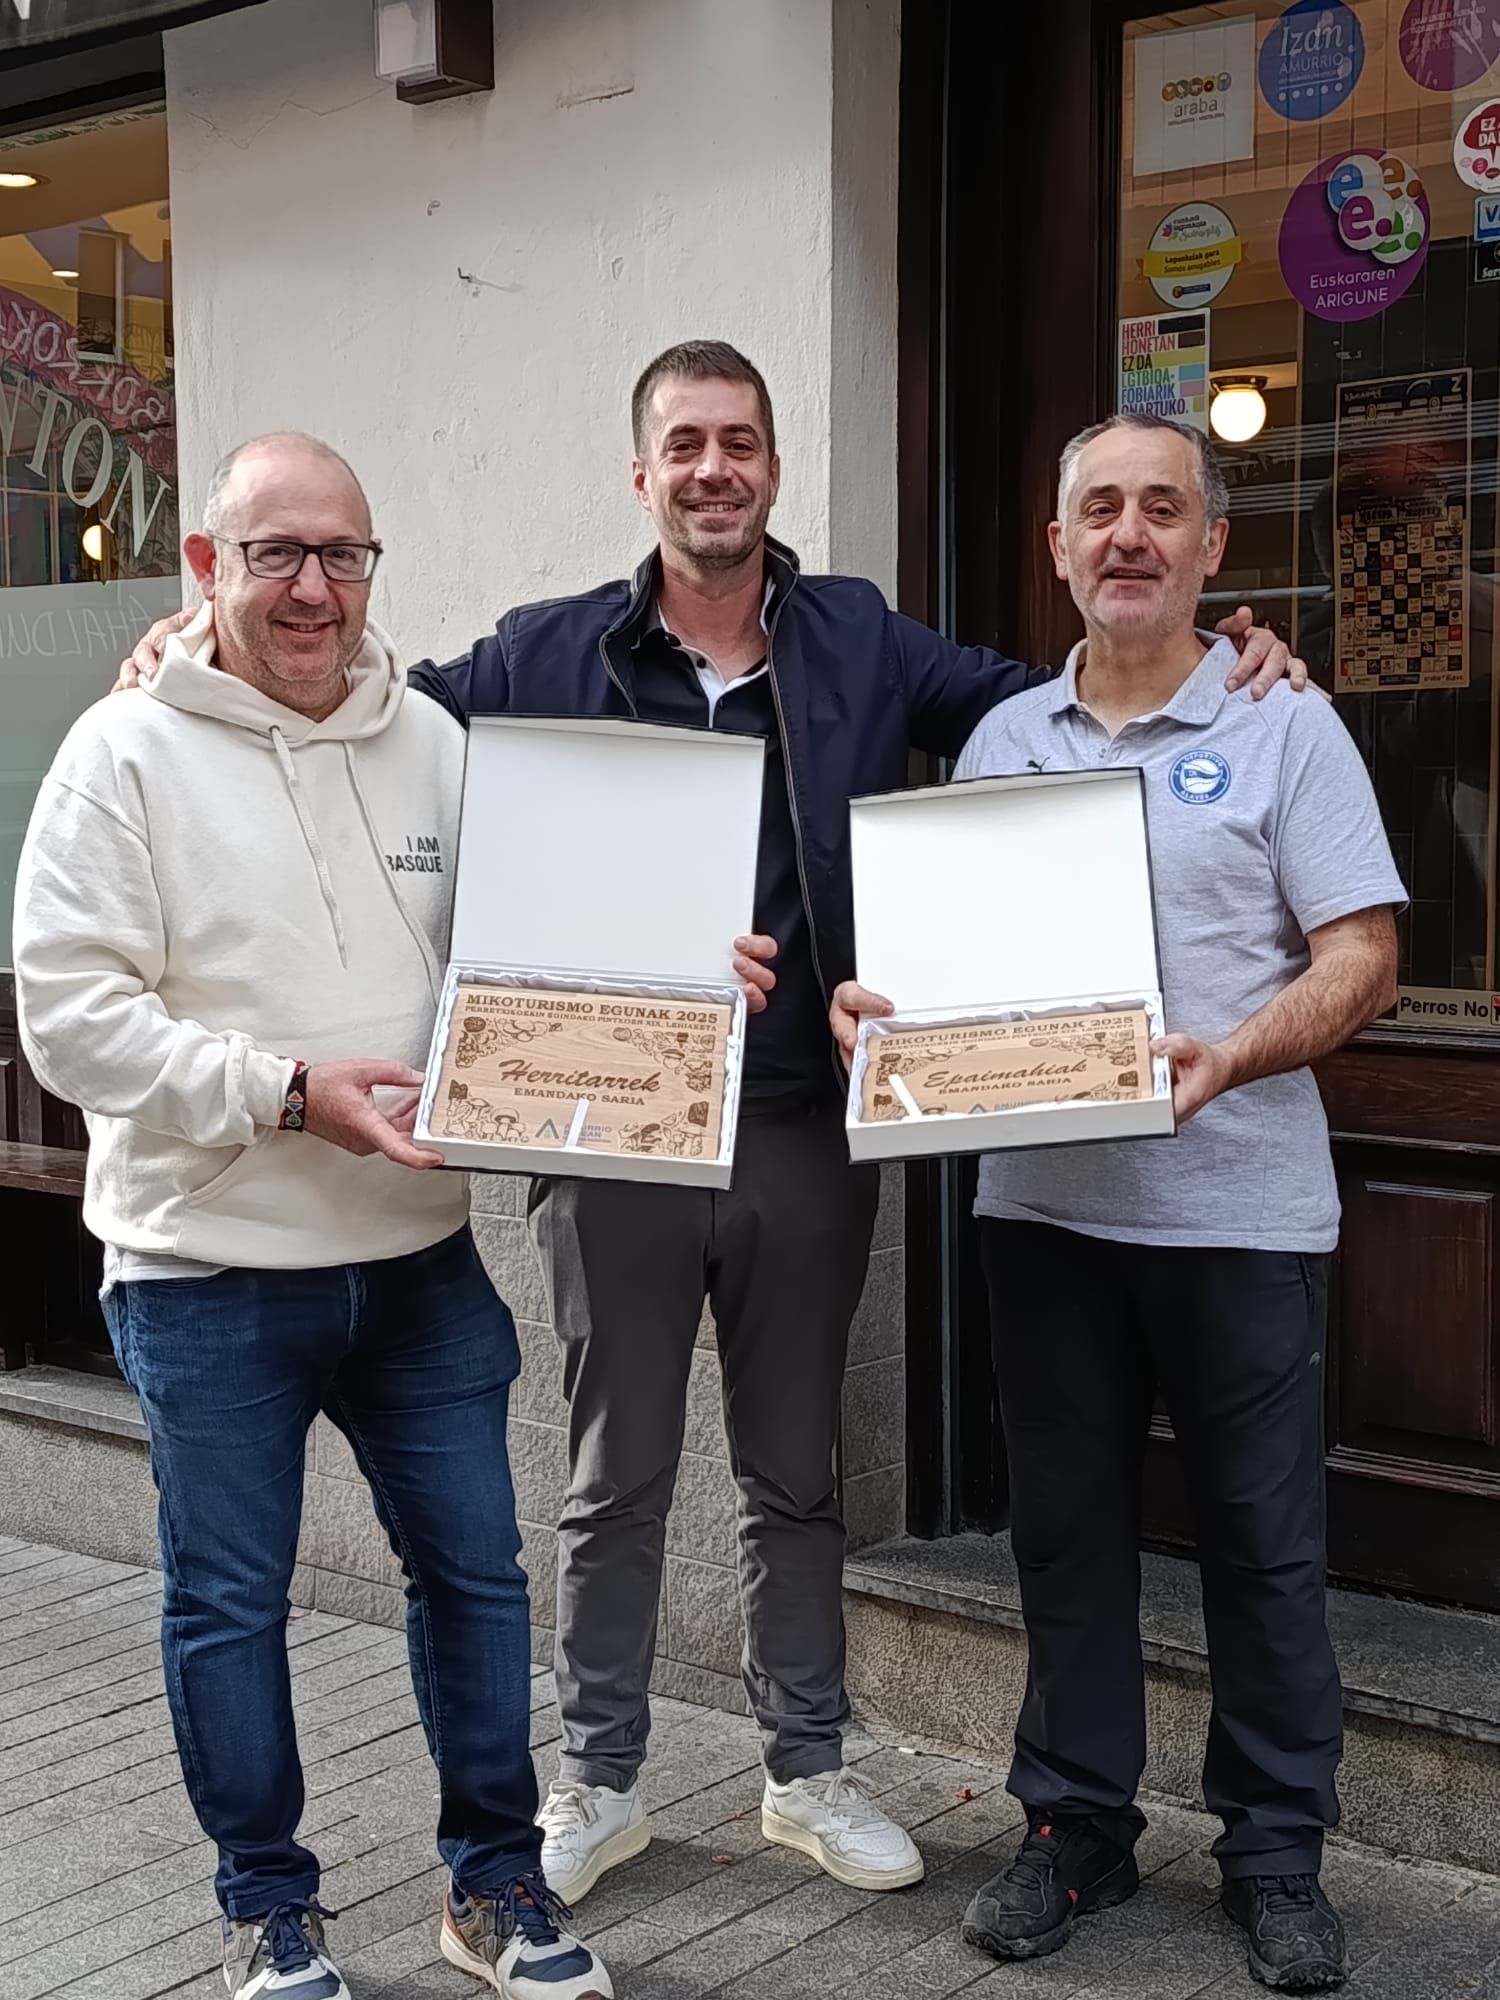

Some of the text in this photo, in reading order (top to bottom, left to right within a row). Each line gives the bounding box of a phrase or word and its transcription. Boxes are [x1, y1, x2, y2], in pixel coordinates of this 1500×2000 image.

[1280, 52, 1344, 74] AMURRIO
[1174, 97, 1218, 118] araba
[1480, 117, 1496, 132] EZ
[1478, 133, 1497, 147] DA
[1484, 204, 1500, 223] V
[1310, 268, 1396, 289] Euskararen
[1315, 287, 1388, 309] ARIGUNE
[1122, 320, 1156, 339] HERRI
[1122, 334, 1176, 355] HONETAN
[1122, 353, 1153, 372] EZ DA
[1121, 383, 1176, 405] FOBIARIK
[406, 835, 440, 853] I AM
[466, 994, 718, 1024] MIKOTURISMO EGUNAK 2025
[1400, 996, 1489, 1018] Perros No
[465, 1005, 545, 1018] PERRETXIKOEKIN
[547, 1012, 596, 1021] EGINDAKO
[597, 1016, 644, 1025] PINTXOEN
[666, 1022, 717, 1031] LEHIAKETA
[880, 1016, 1133, 1047] MIKOTURISMO EGUNAK 2025
[498, 1059, 662, 1092] Herritarrek
[923, 1058, 1087, 1088] Epaimahiak
[514, 1087, 646, 1106] EMANDAKO SARIA
[938, 1077, 1072, 1095] EMANDAKO SARIA
